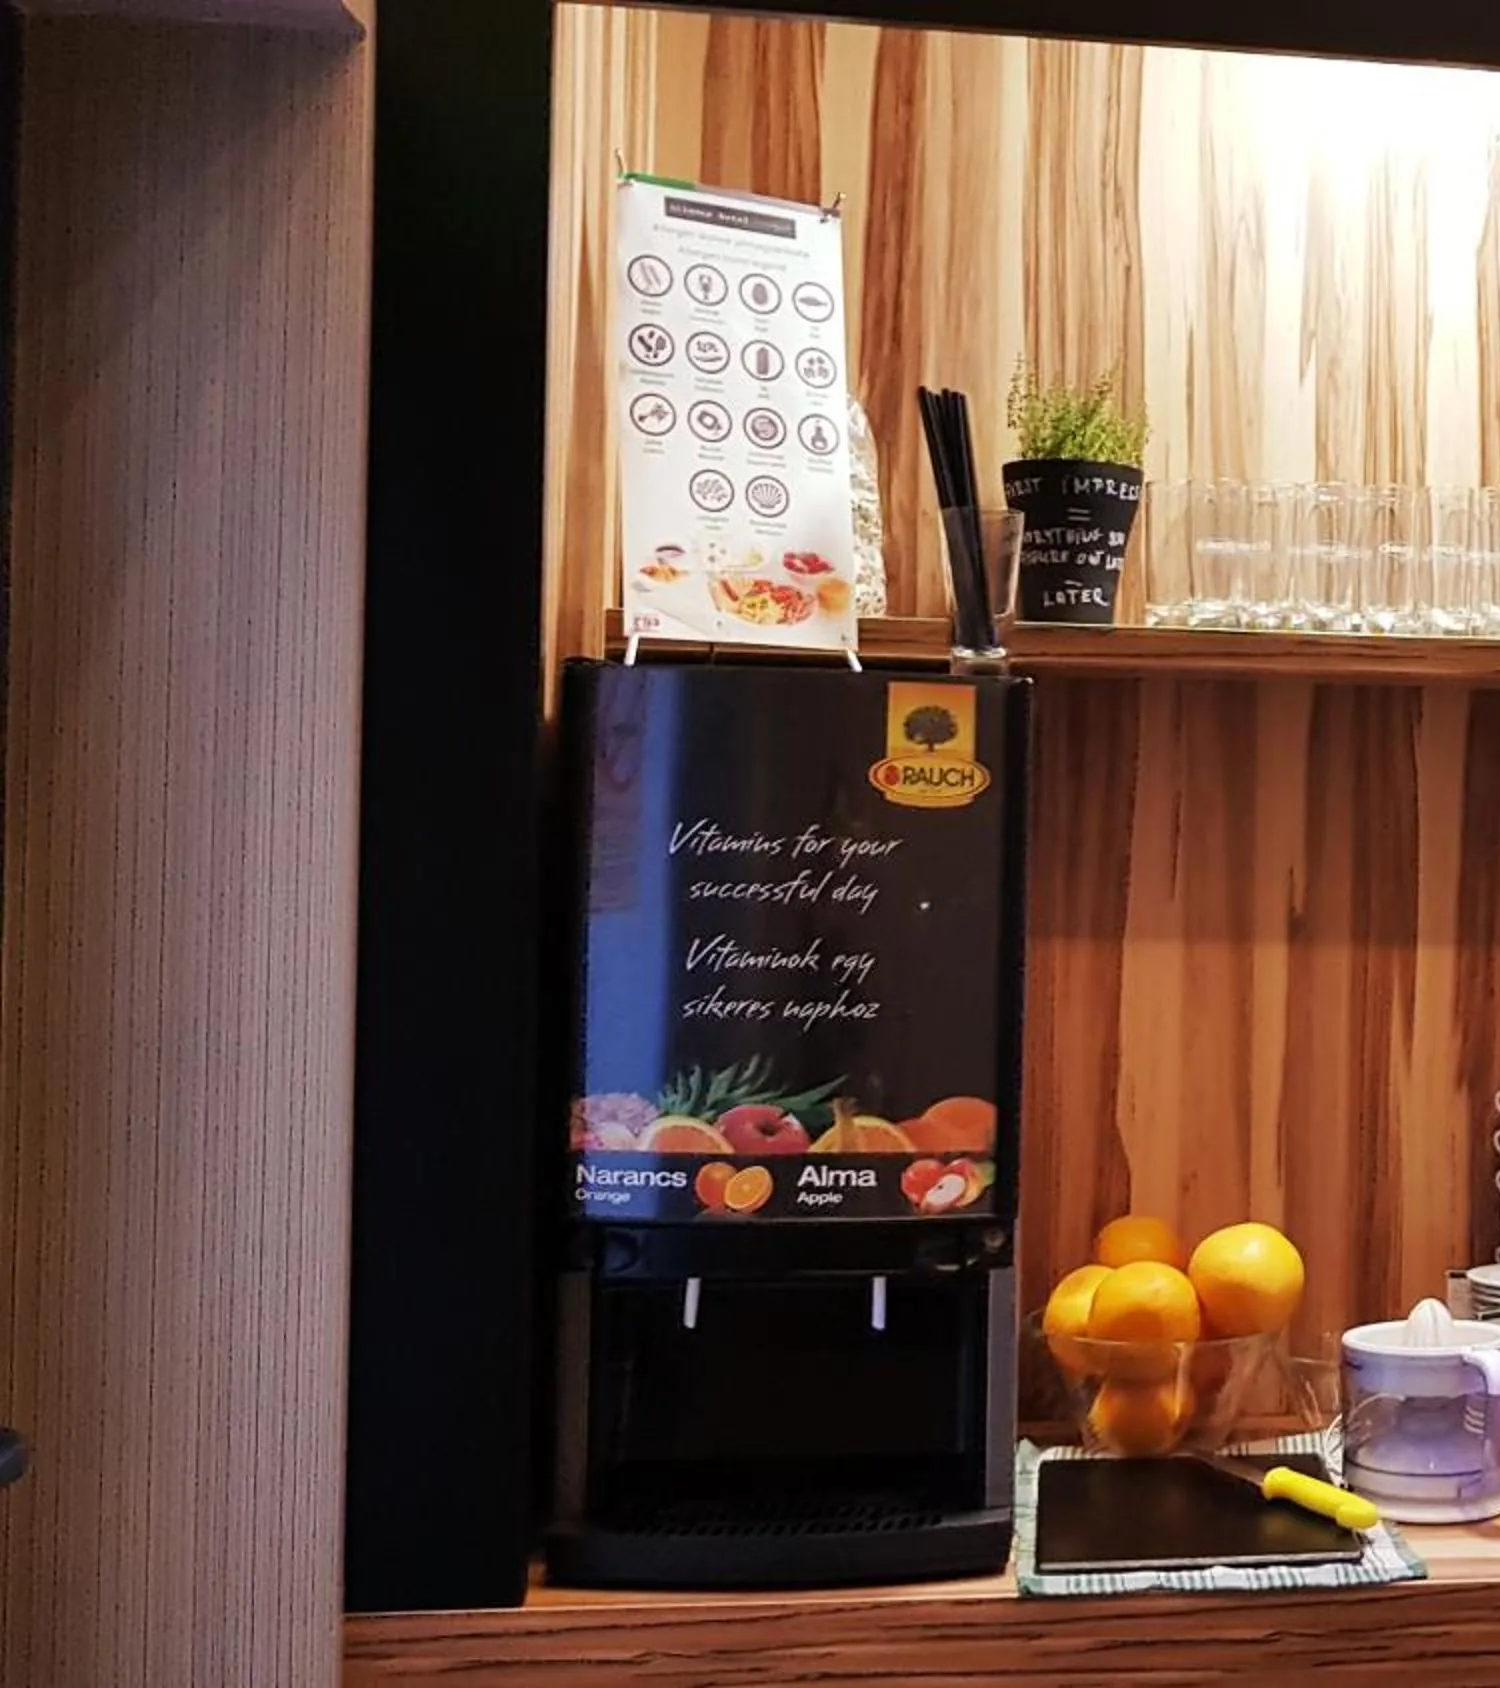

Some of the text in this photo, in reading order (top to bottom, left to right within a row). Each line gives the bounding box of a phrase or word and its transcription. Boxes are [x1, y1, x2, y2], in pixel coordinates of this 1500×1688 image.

[903, 766, 975, 787] RAUCH
[669, 817, 904, 869] Vitamins for your
[689, 869, 881, 914] successful day
[686, 933, 876, 985] Vitaminok egy
[681, 984, 881, 1033] sikeres naphoz
[574, 1187, 844, 1205] Orange Apple
[575, 1164, 878, 1188] Narancs Alma
